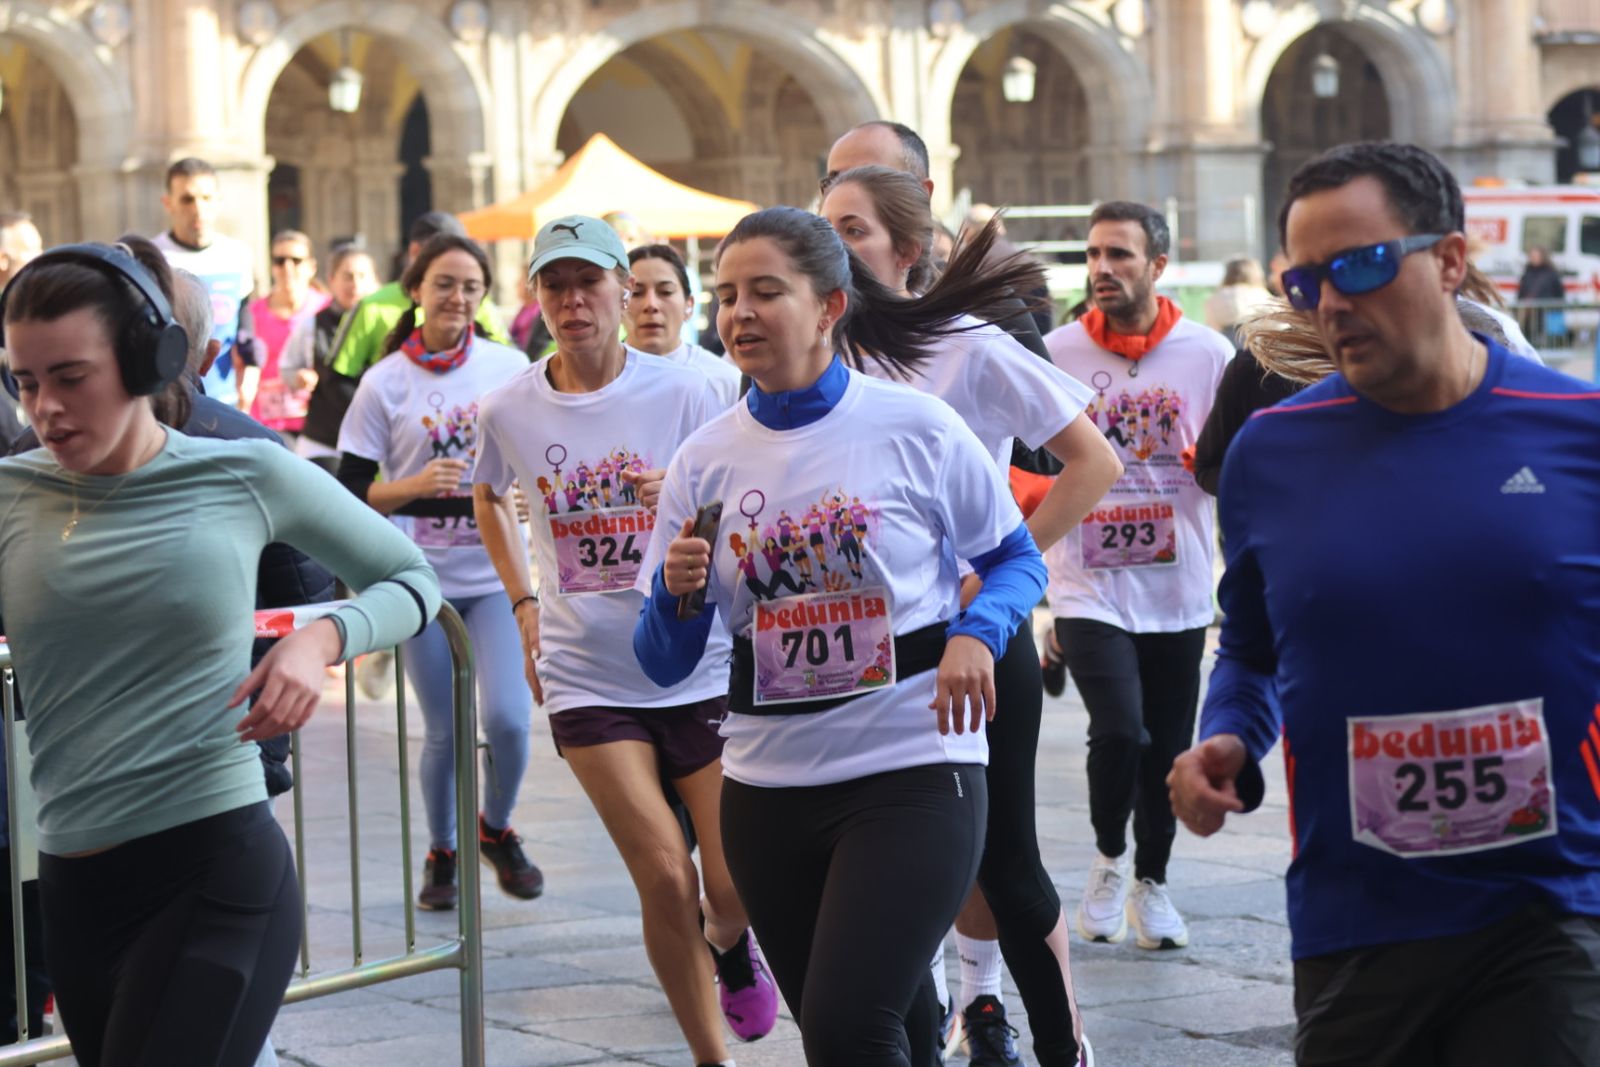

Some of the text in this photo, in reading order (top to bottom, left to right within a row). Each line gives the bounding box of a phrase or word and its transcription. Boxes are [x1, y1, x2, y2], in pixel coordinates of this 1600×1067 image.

[579, 535, 642, 567] 324
[1101, 522, 1156, 549] 293
[757, 595, 886, 632] bedunia
[782, 624, 854, 668] 701
[1353, 713, 1541, 760] bedunia
[1395, 756, 1507, 811] 255
